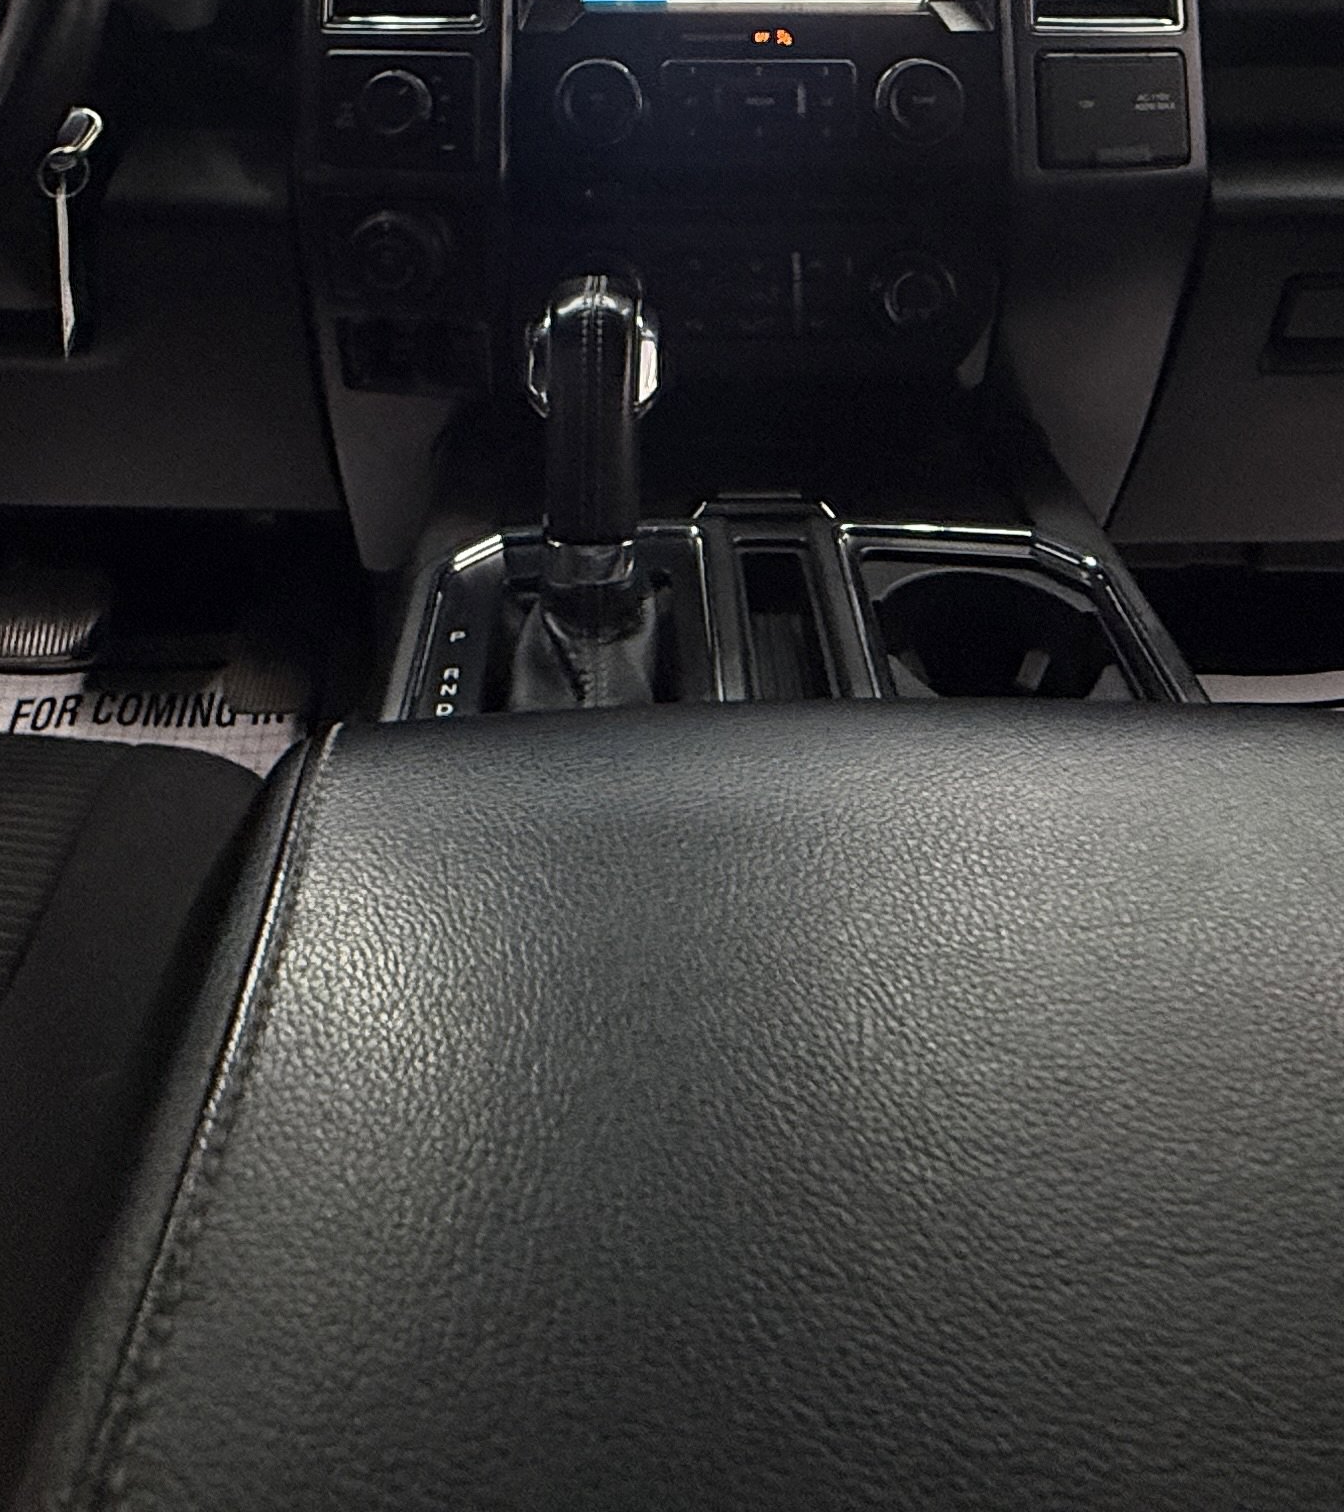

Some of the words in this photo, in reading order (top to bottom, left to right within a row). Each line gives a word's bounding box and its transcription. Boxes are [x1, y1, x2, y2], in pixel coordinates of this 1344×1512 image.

[450, 631, 466, 643] P
[440, 683, 457, 696] N
[10, 694, 83, 734] FOR
[436, 703, 454, 717] D
